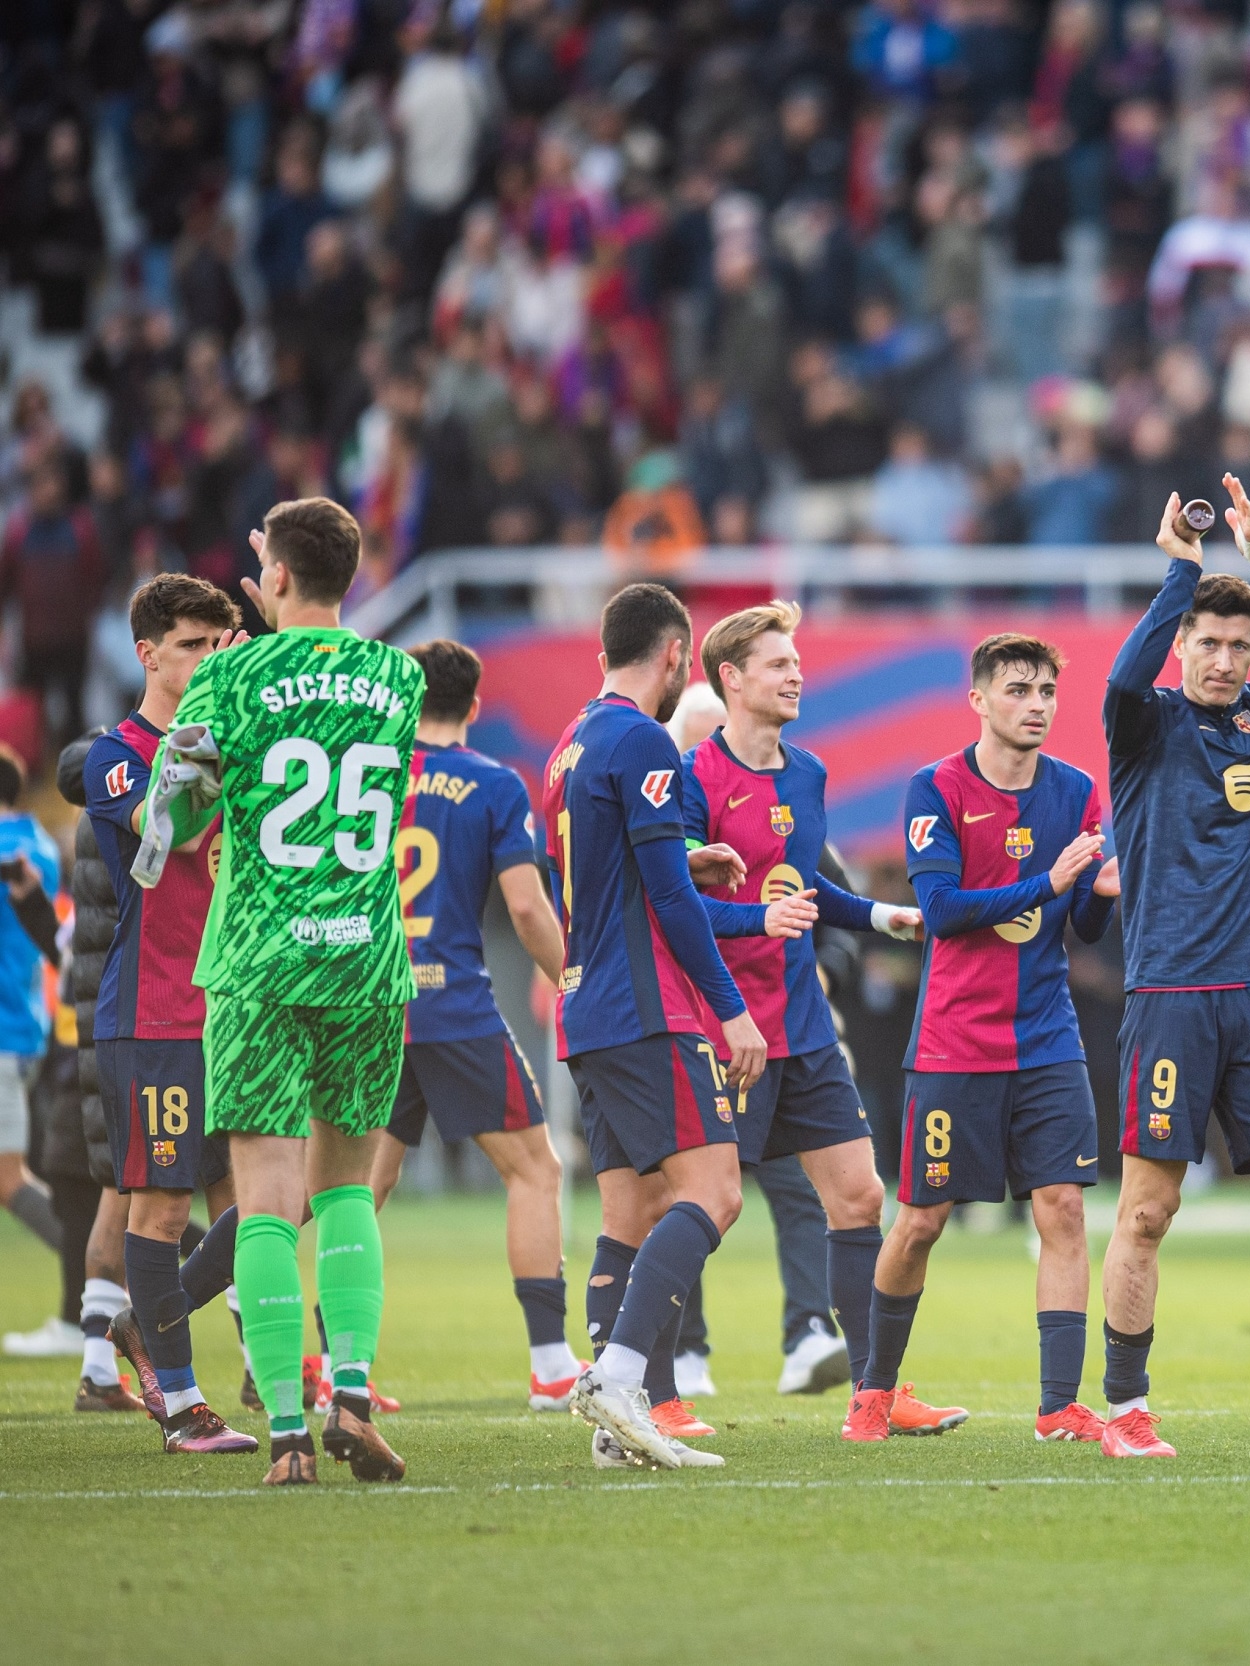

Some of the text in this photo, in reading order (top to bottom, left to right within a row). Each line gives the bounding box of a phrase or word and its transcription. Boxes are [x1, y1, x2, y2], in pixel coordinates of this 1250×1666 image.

[259, 673, 405, 719] SZCZĘSNY
[259, 737, 401, 872] 25
[394, 826, 440, 938] 2
[321, 915, 368, 932] UNHCR
[325, 928, 372, 945] ACNUR
[1151, 1058, 1177, 1109] 9
[141, 1085, 189, 1136] 18
[925, 1109, 951, 1158] 8
